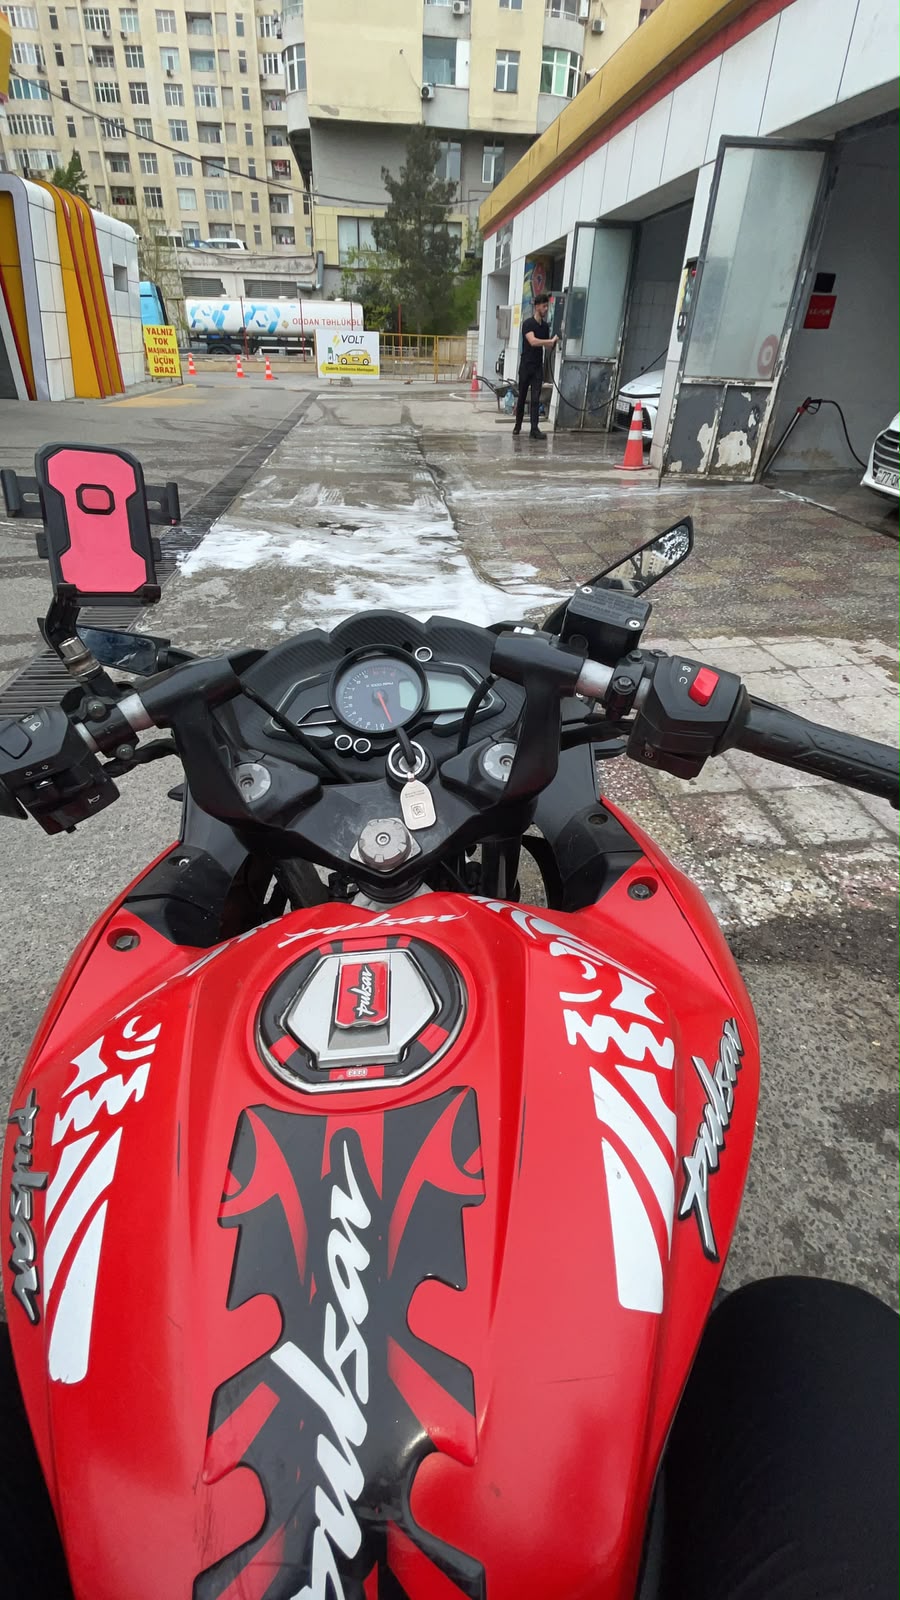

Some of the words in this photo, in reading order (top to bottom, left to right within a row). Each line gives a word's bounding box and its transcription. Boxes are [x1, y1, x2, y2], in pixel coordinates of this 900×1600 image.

[146, 327, 173, 336] YALNIZ
[153, 337, 169, 345] TOK
[341, 334, 364, 345] VOLT
[153, 355, 174, 365] ÜÇÜN
[350, 965, 375, 1017] pulsar
[679, 1017, 746, 1262] pulsar
[7, 1087, 50, 1326] pulsar
